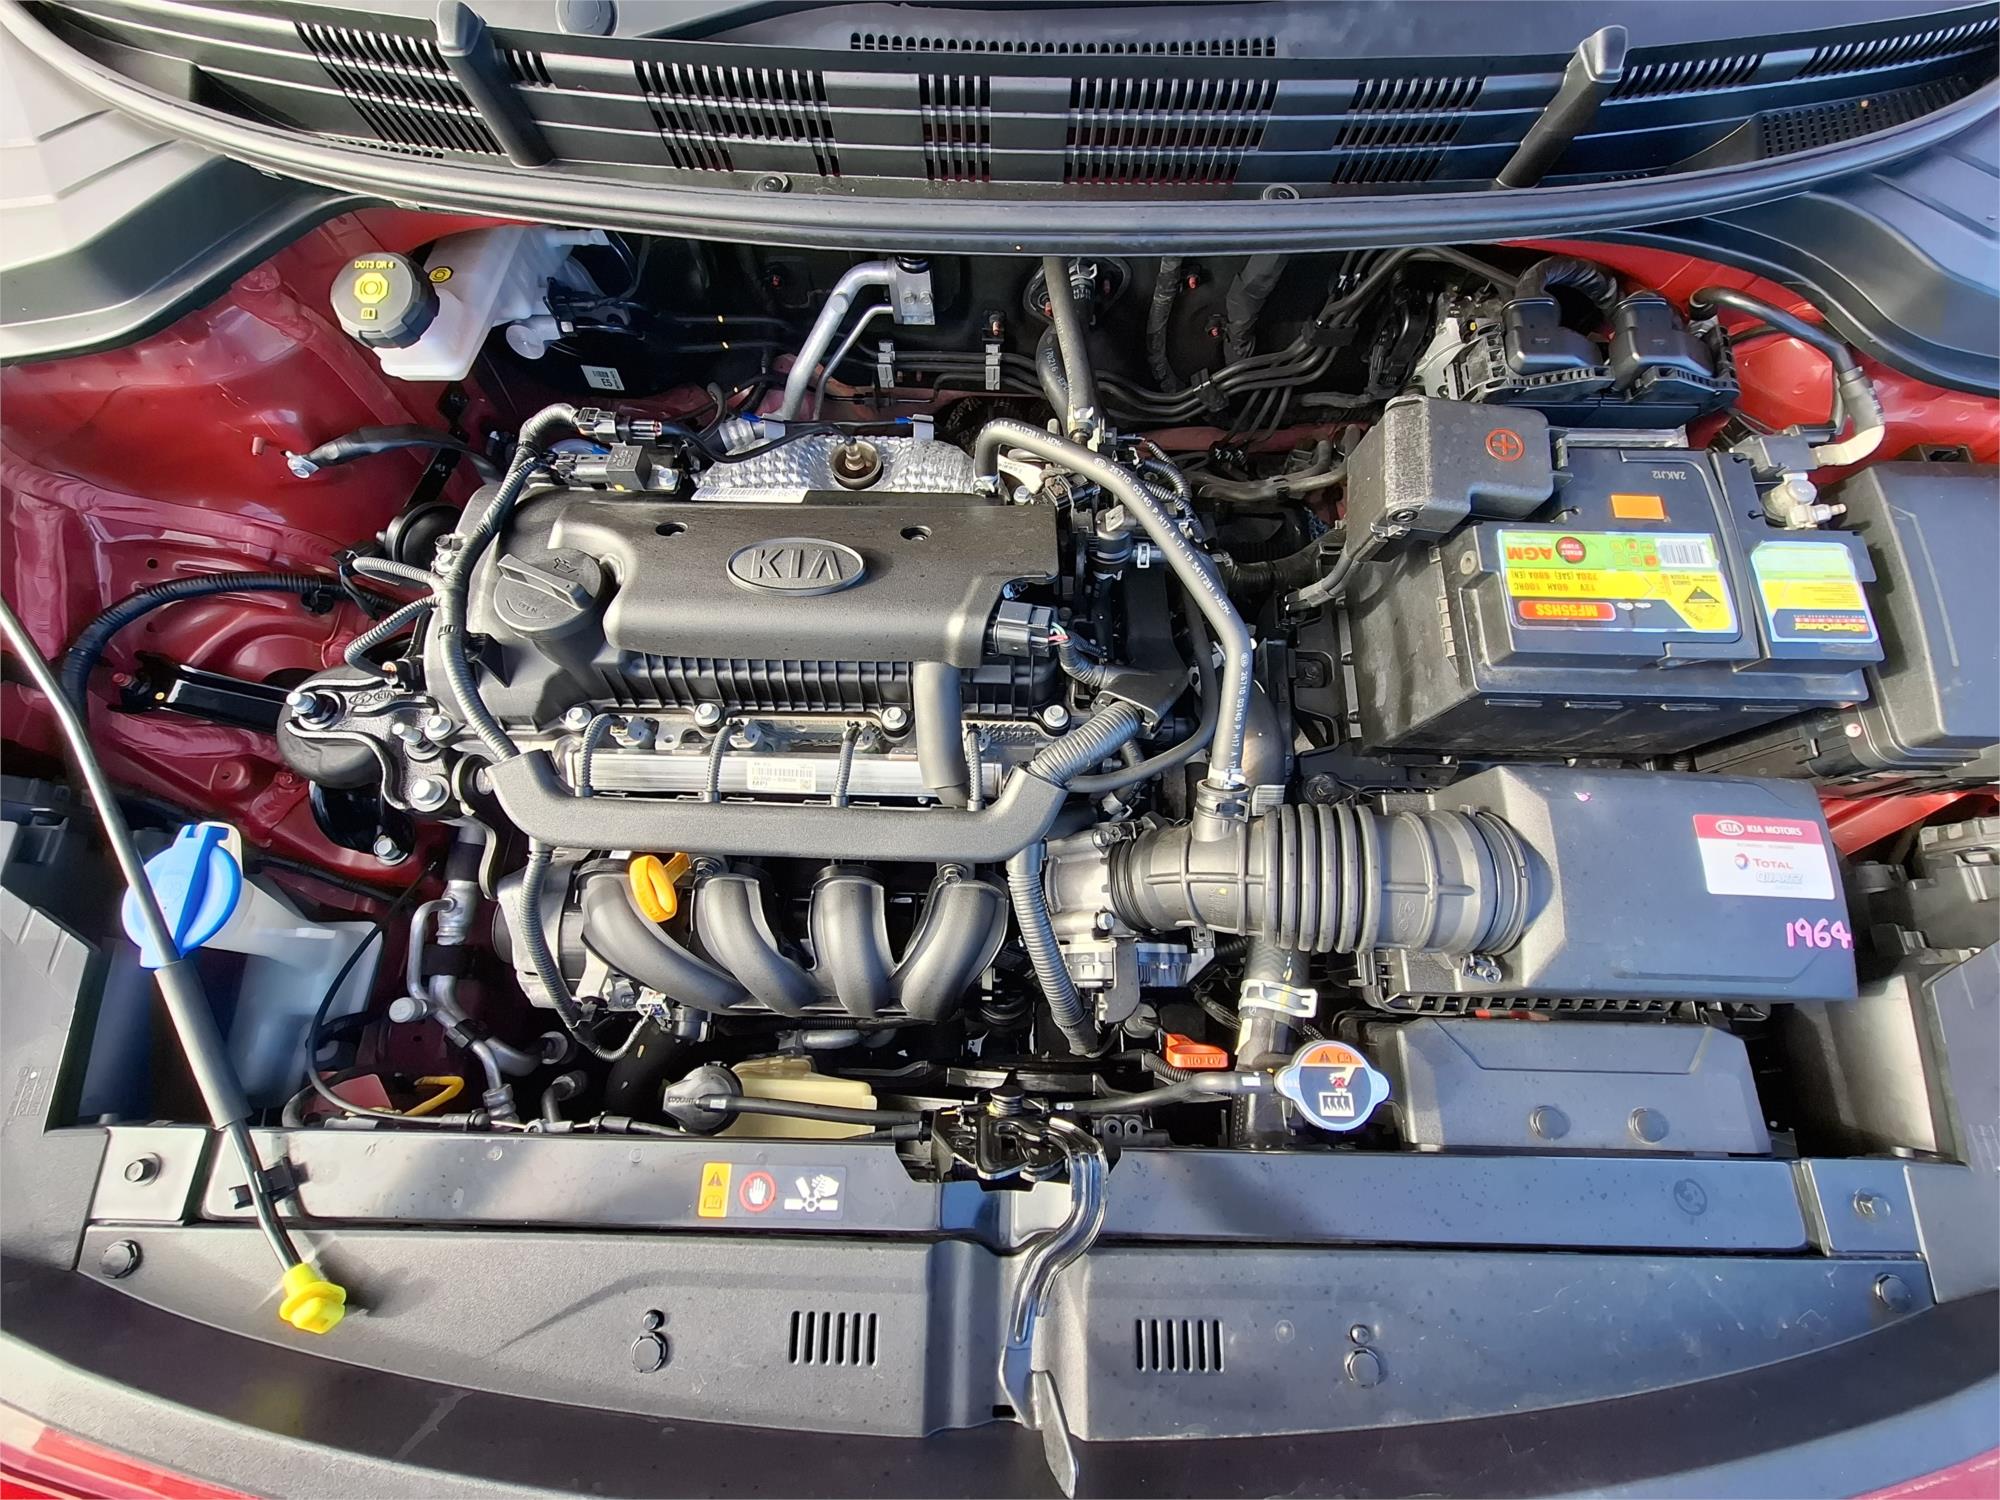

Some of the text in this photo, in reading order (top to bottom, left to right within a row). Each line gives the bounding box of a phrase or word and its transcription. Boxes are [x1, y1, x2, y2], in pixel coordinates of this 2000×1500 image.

[354, 261, 374, 269] DOT3
[375, 261, 386, 269] OR
[1109, 465, 1132, 484] 26710
[1506, 547, 1553, 561] AGM
[750, 548, 844, 581] KIA
[1536, 603, 1599, 618] MF55HSS
[1746, 824, 1764, 834] KIA
[1765, 825, 1803, 836] MOTORS
[1753, 857, 1794, 870] TOTAL
[1786, 917, 1852, 949] 1964
